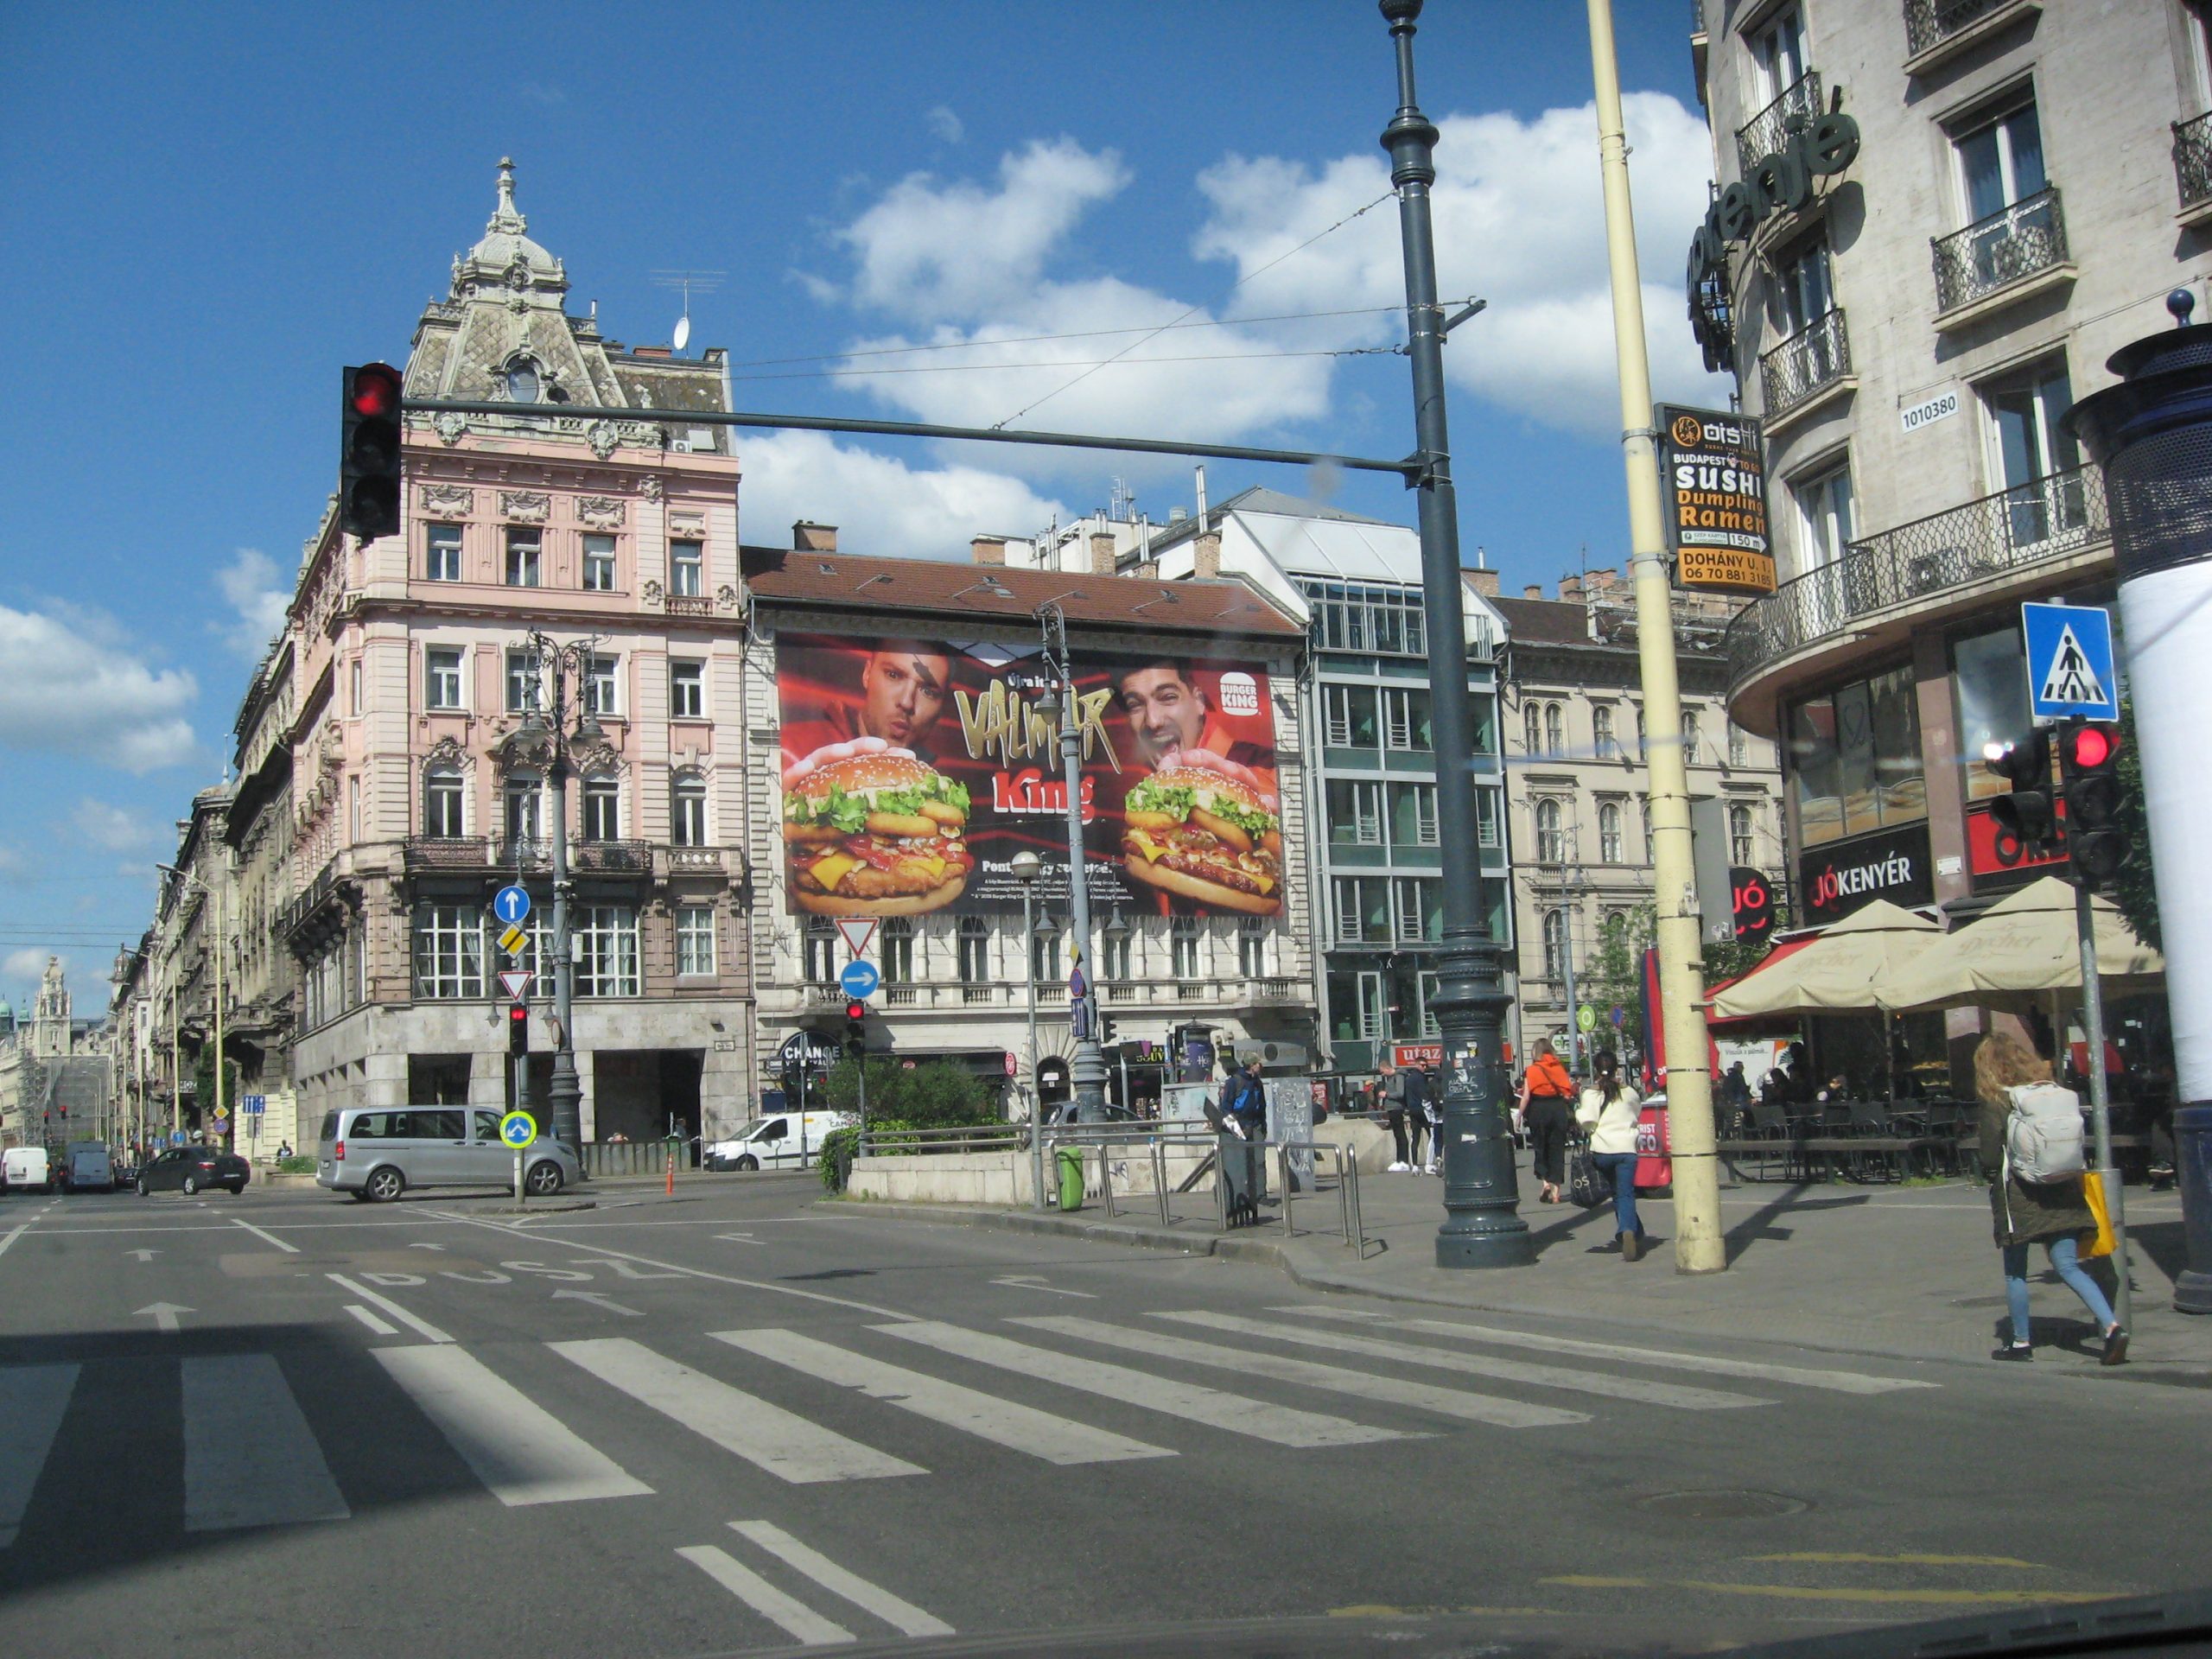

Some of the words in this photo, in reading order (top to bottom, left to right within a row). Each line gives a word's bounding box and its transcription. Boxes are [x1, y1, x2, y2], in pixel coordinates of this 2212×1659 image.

[1903, 397, 1956, 429] 1010380
[1673, 454, 1726, 466] BUDAPEST
[1739, 461, 1749, 469] TO
[1675, 466, 1761, 499] SUSHI
[1677, 490, 1764, 515] Dumpling
[1679, 505, 1765, 535] Ramen
[1732, 535, 1750, 546] 150
[1684, 550, 1744, 568] DOHÁNY
[1748, 558, 1758, 570] U.
[1685, 568, 1703, 578] 06
[1707, 569, 1722, 579] 70
[1726, 569, 1745, 581] 881
[1007, 673, 1033, 689] Újra
[1220, 684, 1256, 695] BURGER
[1221, 694, 1258, 708] KING
[1814, 850, 1912, 907] JÓKENYÉR
[1732, 880, 1765, 913] JÓ
[1403, 1047, 1441, 1061] utaz
[1639, 1123, 1656, 1134] RIST
[1637, 1135, 1656, 1151] FO
